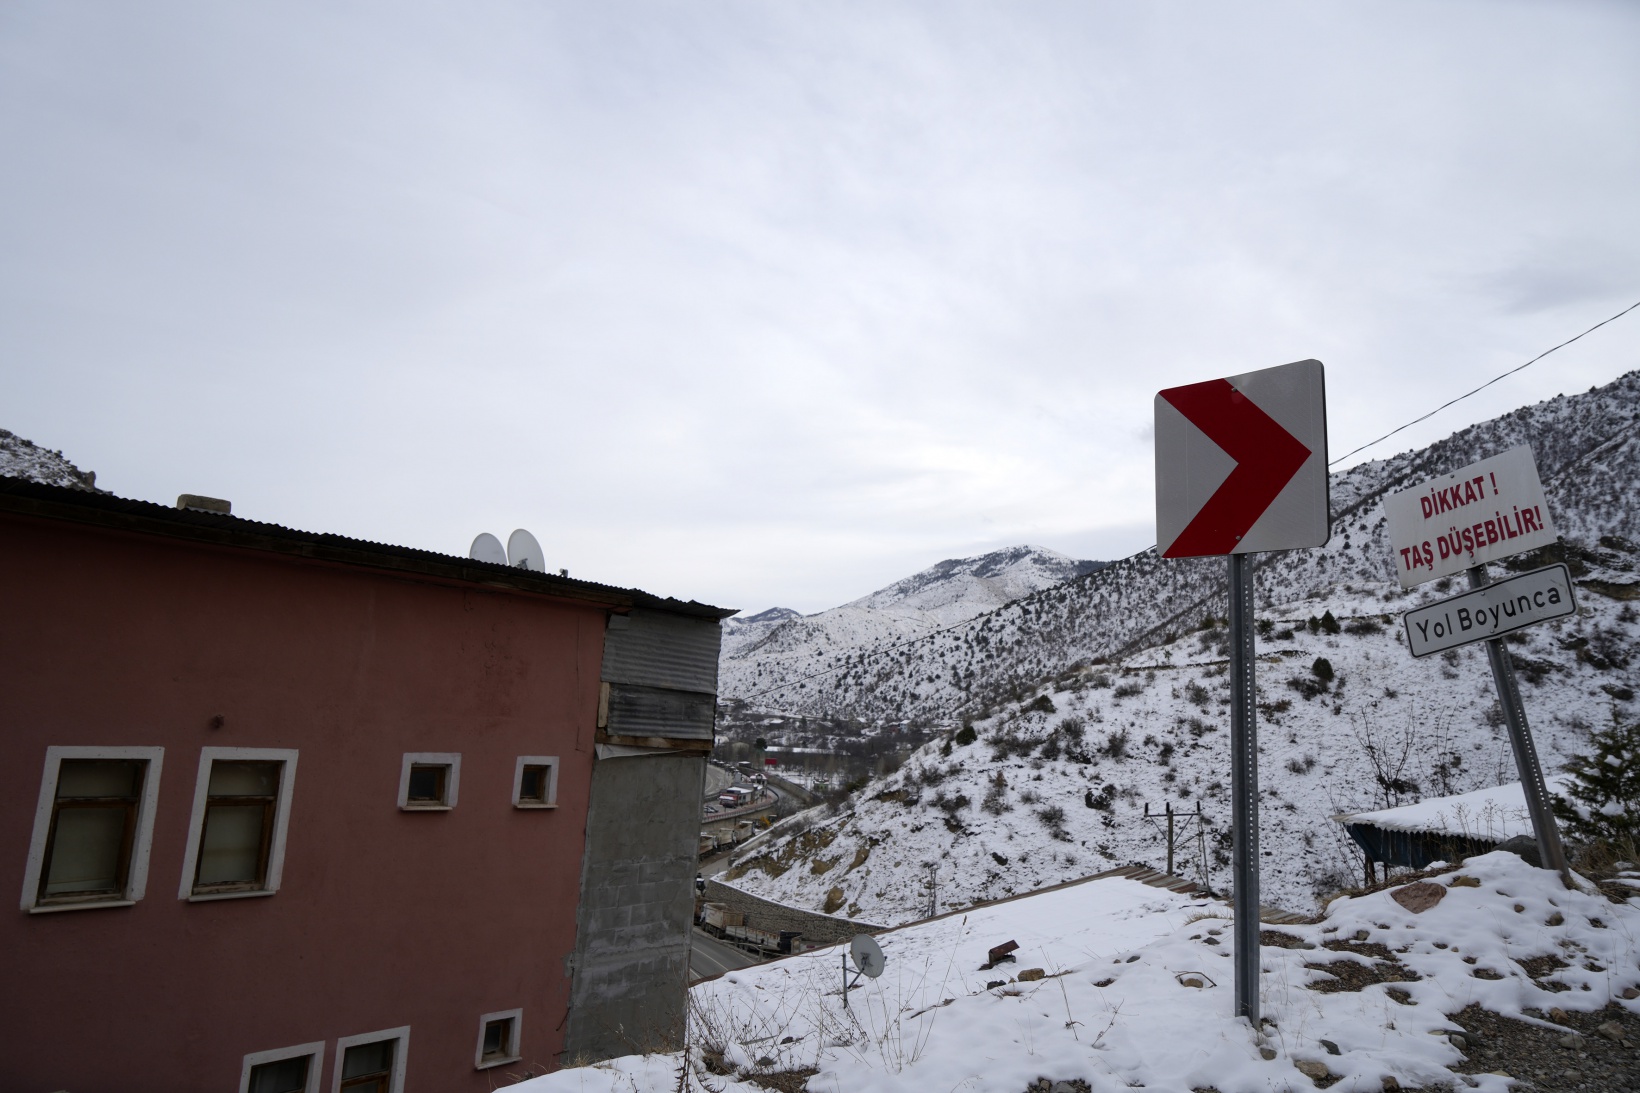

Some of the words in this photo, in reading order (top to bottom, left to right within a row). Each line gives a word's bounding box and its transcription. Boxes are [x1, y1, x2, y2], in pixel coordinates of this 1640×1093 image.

[1420, 475, 1485, 519] DİKKAT
[1400, 540, 1434, 571] TAŞ
[1437, 505, 1544, 560] DÜŞEBİLİR!
[1416, 613, 1453, 642] Yol
[1457, 586, 1561, 631] Boyunca
